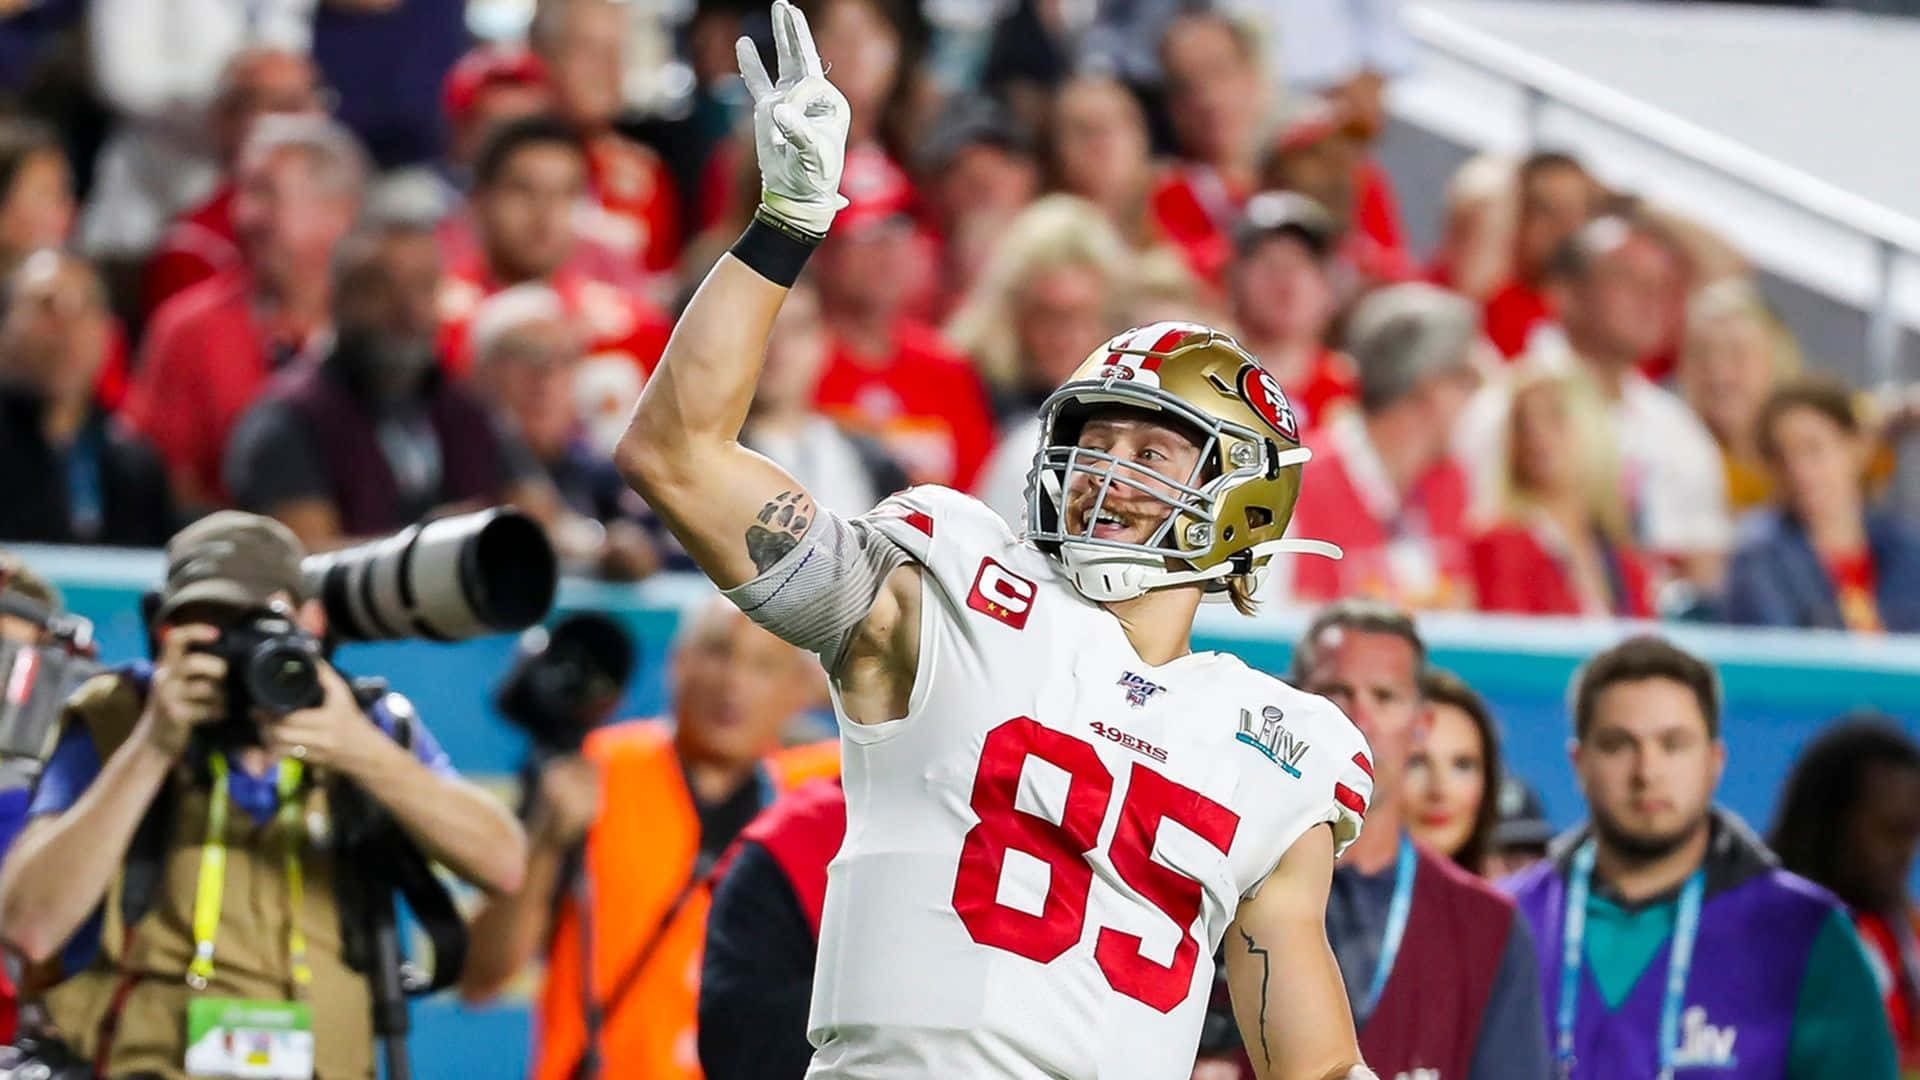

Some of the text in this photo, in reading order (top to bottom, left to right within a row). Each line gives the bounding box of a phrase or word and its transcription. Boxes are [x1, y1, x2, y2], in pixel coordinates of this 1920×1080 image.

[978, 564, 1033, 614] C
[1089, 721, 1168, 761] 49ERS
[1238, 706, 1311, 768] LIV
[951, 716, 1241, 1014] 85
[1672, 1005, 1737, 1064] IV
